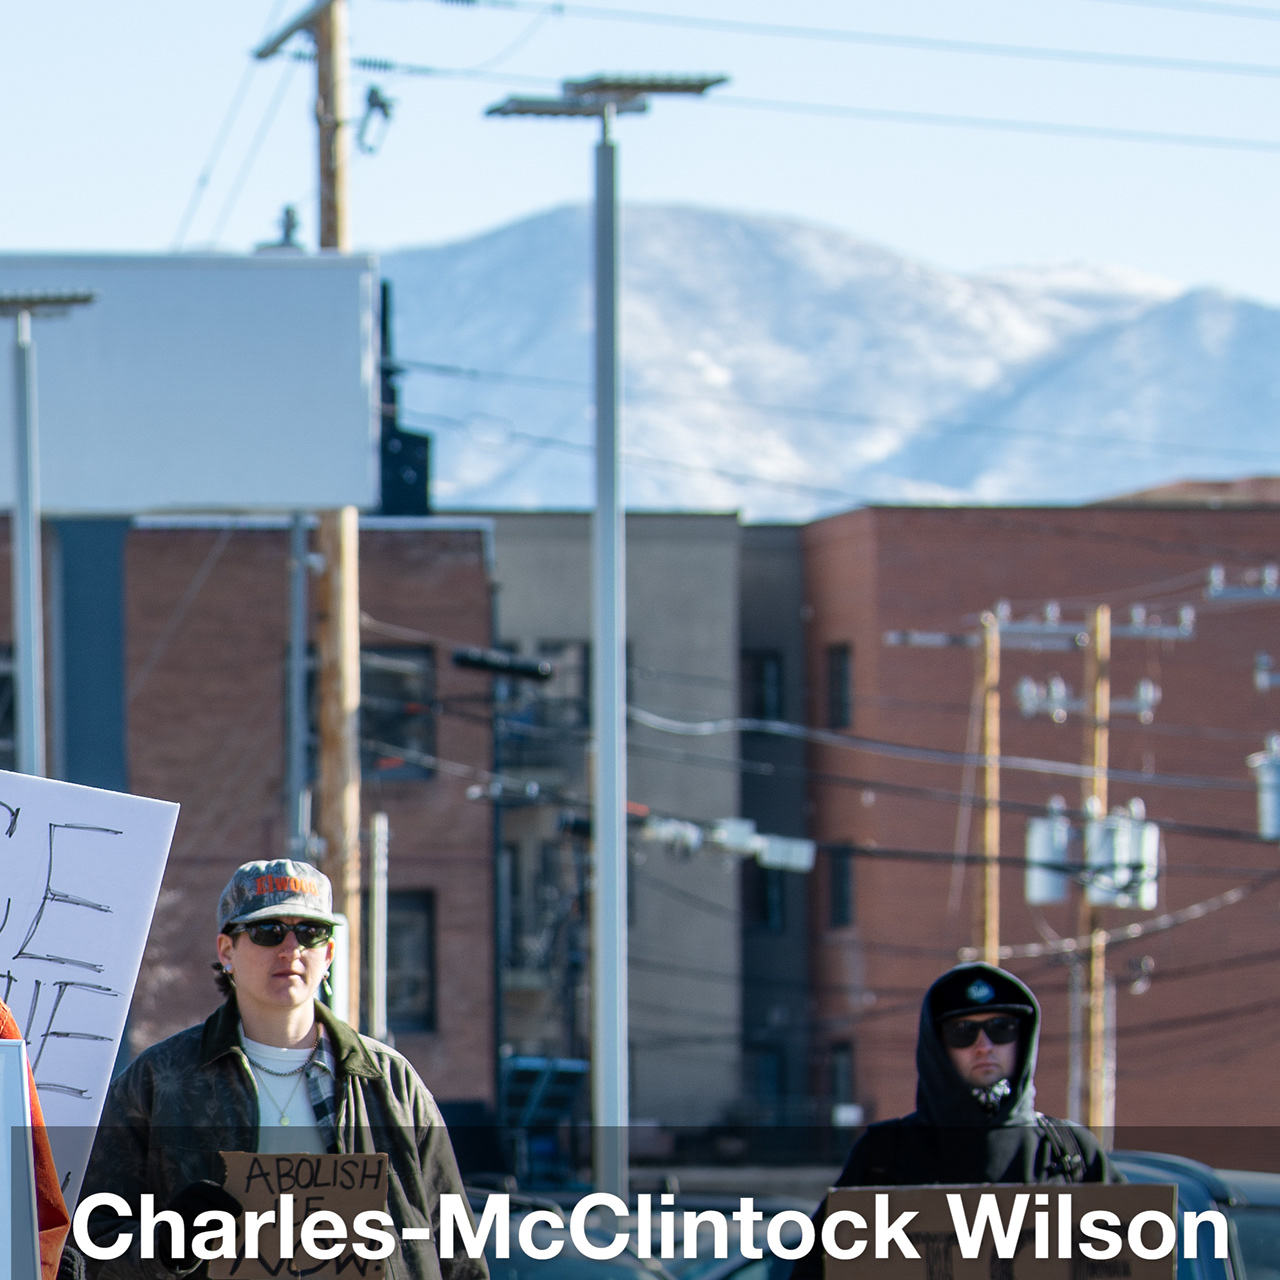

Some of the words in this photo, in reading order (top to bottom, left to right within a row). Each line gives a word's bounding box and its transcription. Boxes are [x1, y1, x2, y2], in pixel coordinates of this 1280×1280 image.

[255, 874, 319, 897] Elwood
[245, 1157, 383, 1195] ABOLISH
[272, 1196, 324, 1229] IE
